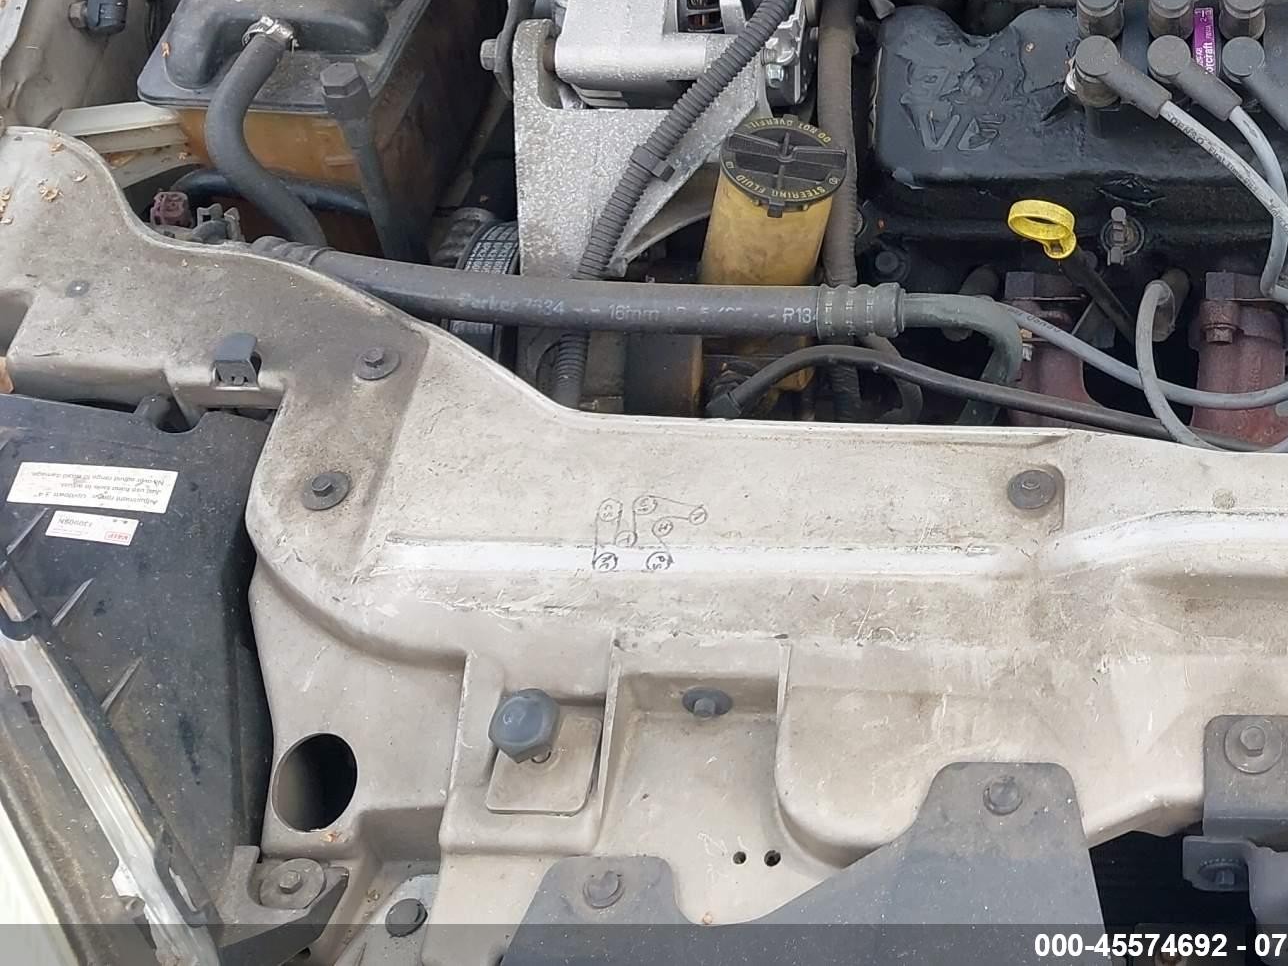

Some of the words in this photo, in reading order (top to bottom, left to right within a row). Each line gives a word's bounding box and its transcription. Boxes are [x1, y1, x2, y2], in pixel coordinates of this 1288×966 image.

[799, 123, 818, 134] NOT
[818, 132, 832, 143] DO
[736, 174, 766, 194] FLUID
[771, 186, 826, 199] STEERING
[782, 307, 817, 324] R13
